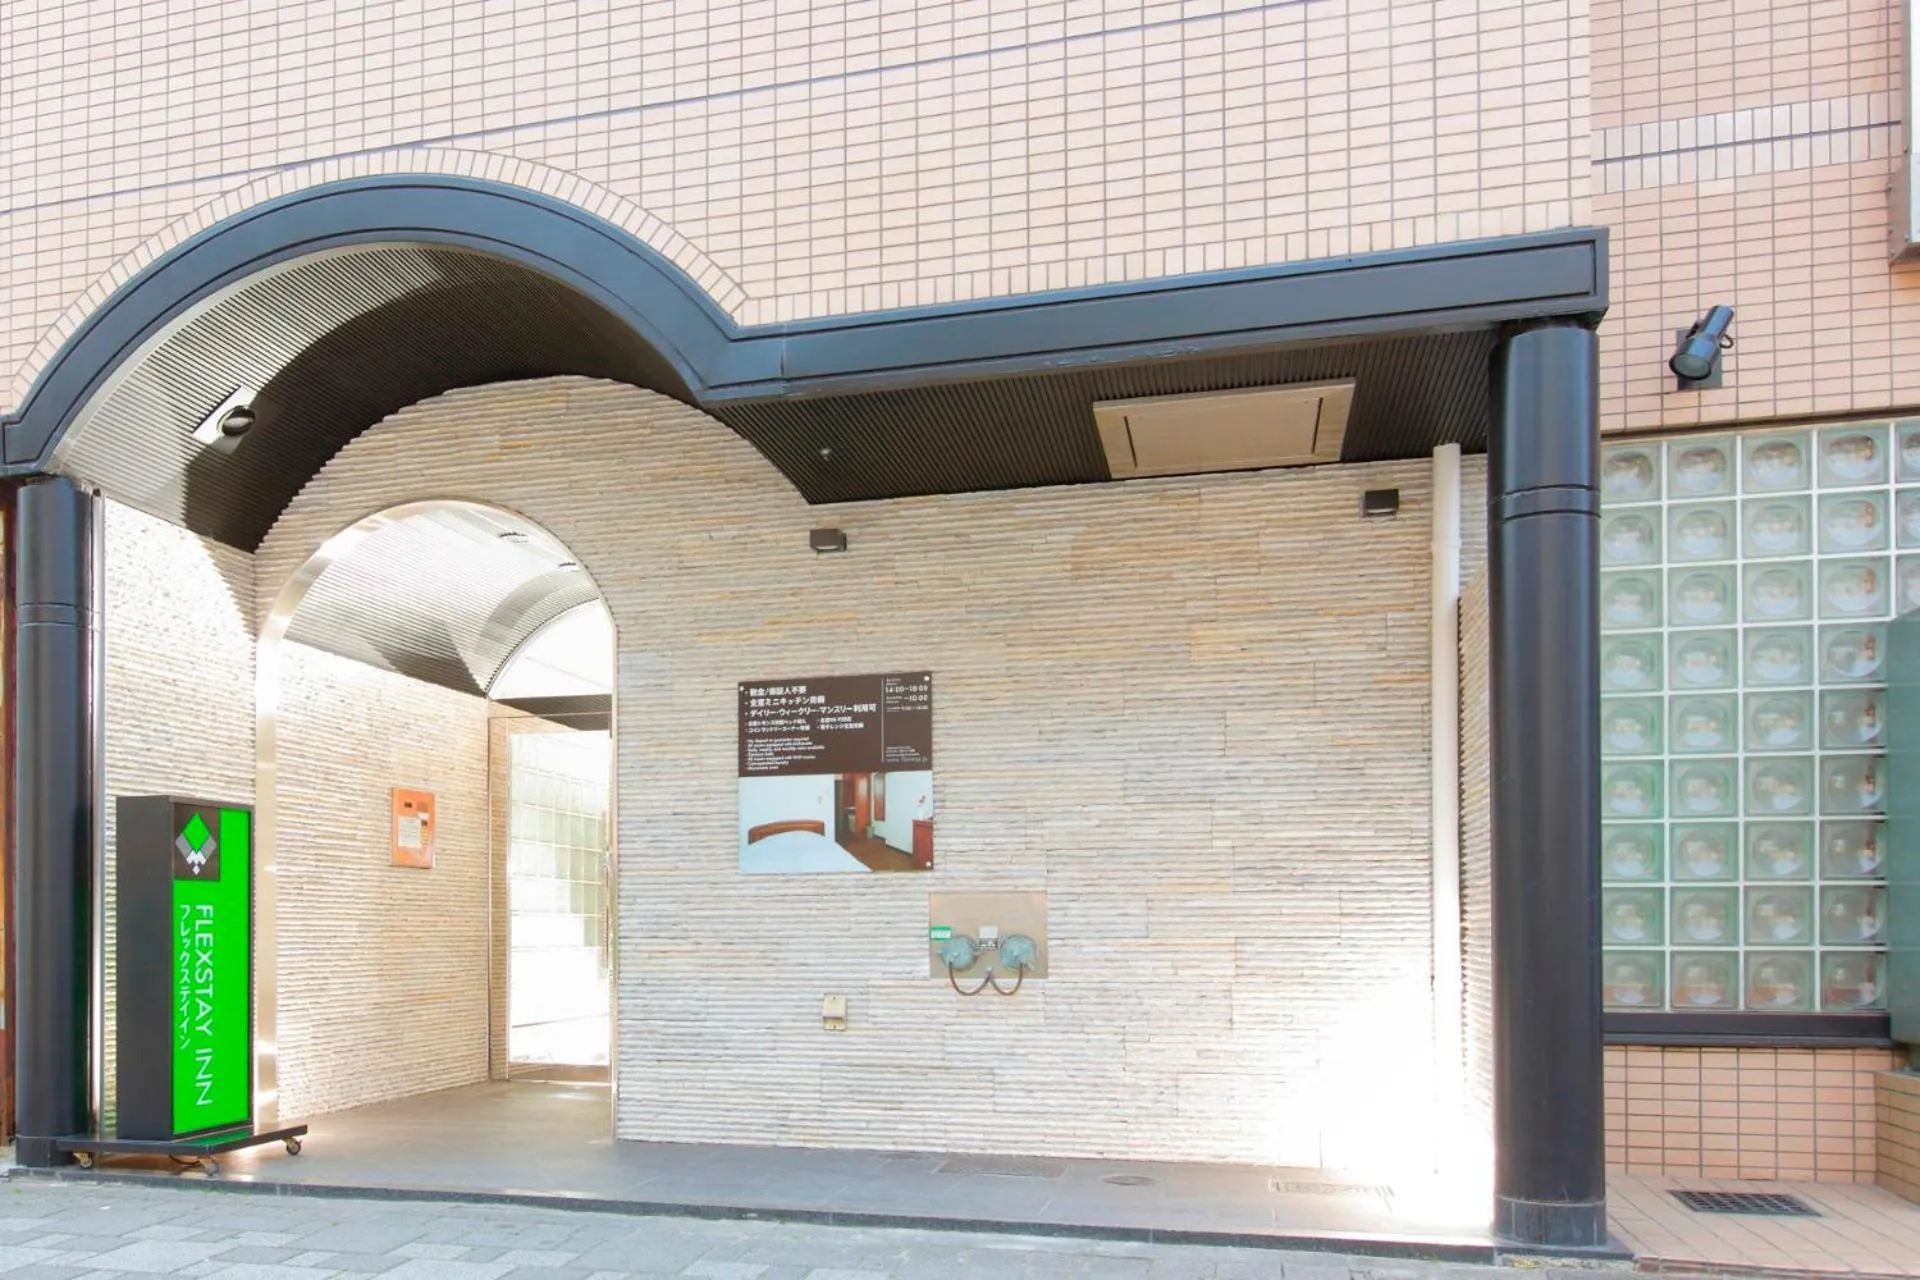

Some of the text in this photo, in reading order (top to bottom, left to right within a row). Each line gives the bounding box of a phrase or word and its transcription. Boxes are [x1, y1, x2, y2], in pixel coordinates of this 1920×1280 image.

[179, 904, 191, 1050] フレックステイイン
[195, 904, 214, 1106] FLEXSTAY INN
